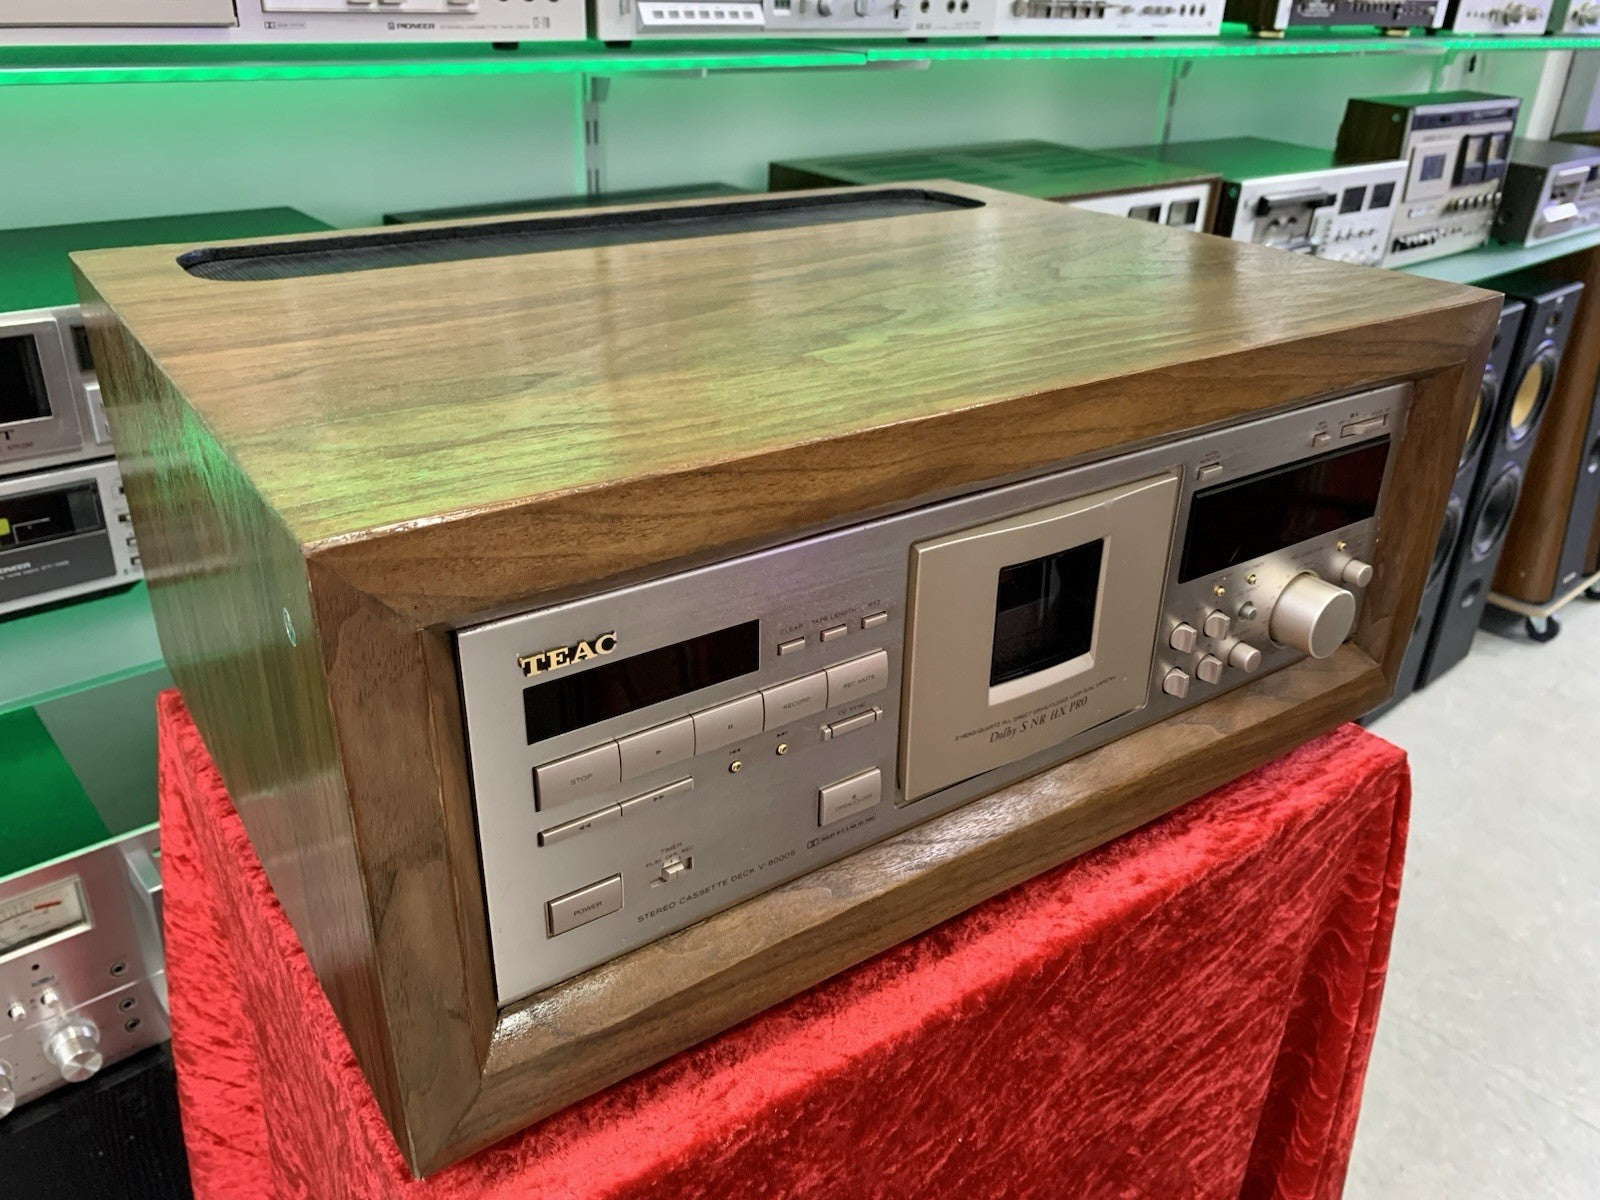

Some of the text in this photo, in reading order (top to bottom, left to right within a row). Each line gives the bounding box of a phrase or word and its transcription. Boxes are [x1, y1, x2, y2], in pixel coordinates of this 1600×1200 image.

[396, 22, 436, 30] PIONEER
[517, 630, 618, 677] TEAC
[783, 696, 811, 710] RECORD
[989, 696, 1088, 743] Dolby S NR HX PRO
[569, 772, 593, 786] STOP
[660, 841, 683, 855] TIMER
[645, 858, 662, 869] PLAY
[637, 901, 676, 923] STEREO
[679, 879, 728, 905] CASSETTE
[730, 868, 755, 883] DECK
[573, 900, 603, 917] POWER
